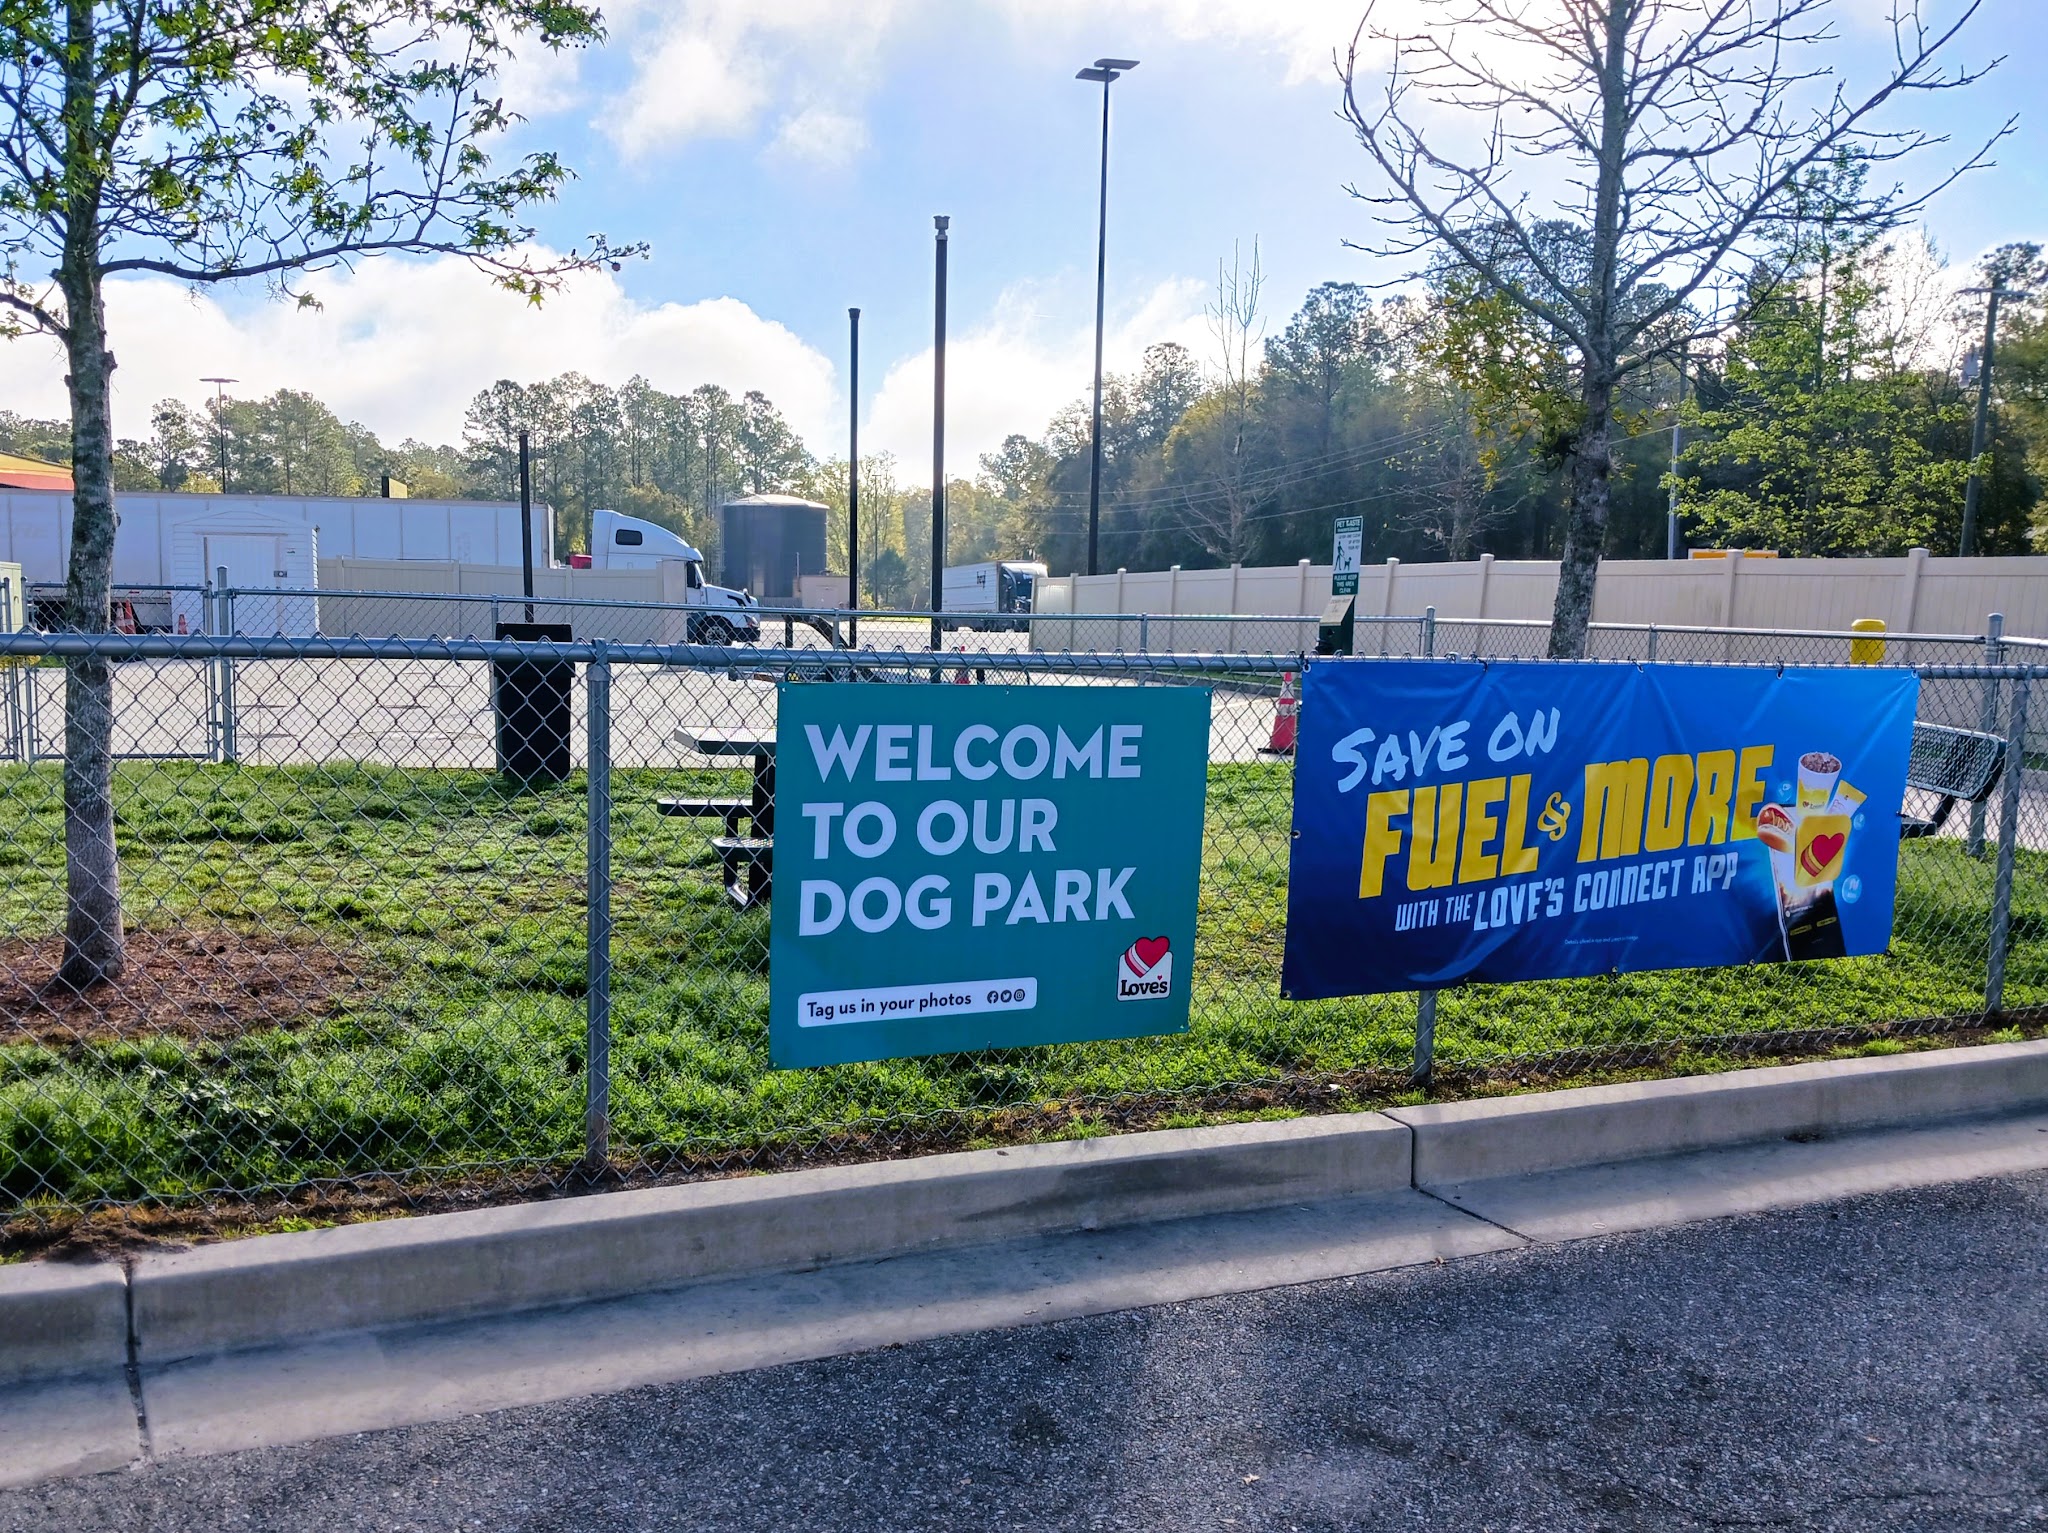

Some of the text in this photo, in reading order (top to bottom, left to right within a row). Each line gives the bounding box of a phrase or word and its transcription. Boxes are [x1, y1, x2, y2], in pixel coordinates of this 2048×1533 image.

[803, 724, 1143, 783] WELCOME
[1332, 707, 1561, 793] SAVE ON
[802, 798, 1058, 859] TO OUR
[1359, 744, 1775, 899] FUEL & MORE
[799, 867, 1137, 936] DOG PARK
[1394, 852, 1739, 932] WITH THE LOVE'S CONNECT APP
[807, 992, 972, 1020] Tag us in your photos
